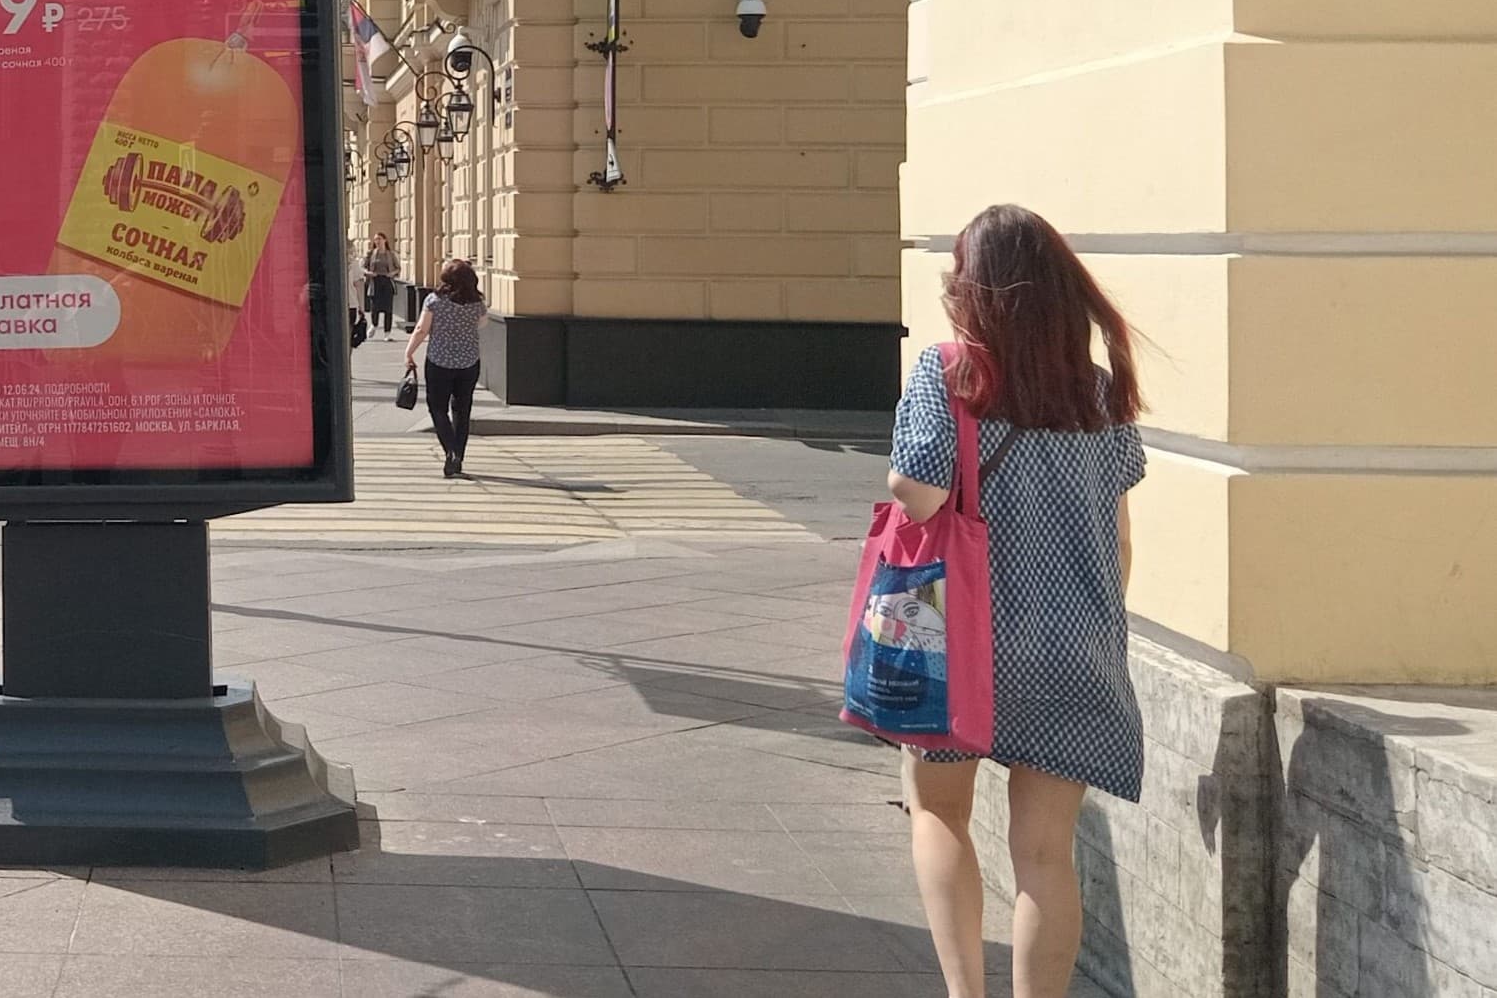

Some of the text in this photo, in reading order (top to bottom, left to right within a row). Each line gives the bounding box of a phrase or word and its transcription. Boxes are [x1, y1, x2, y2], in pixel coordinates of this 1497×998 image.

[77, 5, 131, 32] 275
[2, 60, 41, 70] сочная
[147, 160, 218, 199] ПАПА
[142, 190, 201, 222] МОЖЕТ
[111, 222, 208, 271] СОЧНАЯ
[106, 245, 199, 285] колбаса вареная
[44, 382, 110, 396] ПОДРОБНОСТИ
[201, 393, 237, 405] ТОЧНОЕ
[69, 407, 128, 421] МОБИЛЬНОМ
[37, 423, 61, 434] ОГРН
